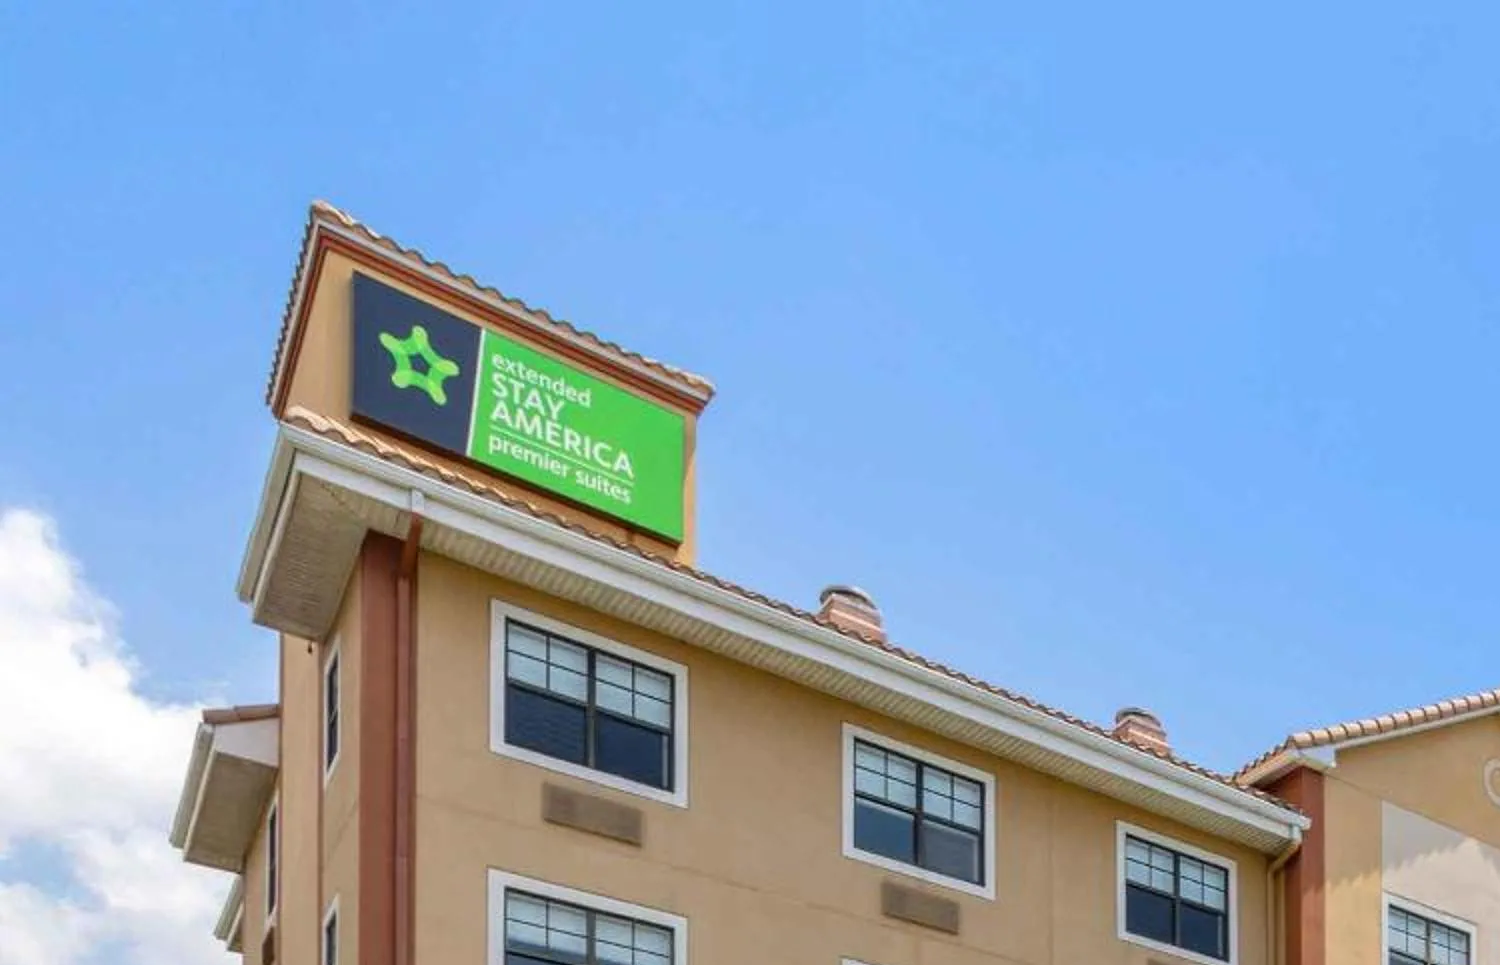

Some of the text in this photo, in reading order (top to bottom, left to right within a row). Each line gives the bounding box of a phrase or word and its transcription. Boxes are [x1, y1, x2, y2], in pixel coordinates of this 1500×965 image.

[491, 373, 565, 421] STAY
[492, 353, 592, 408] extended
[489, 435, 632, 505] premier suites
[490, 401, 635, 480] AMERICA
